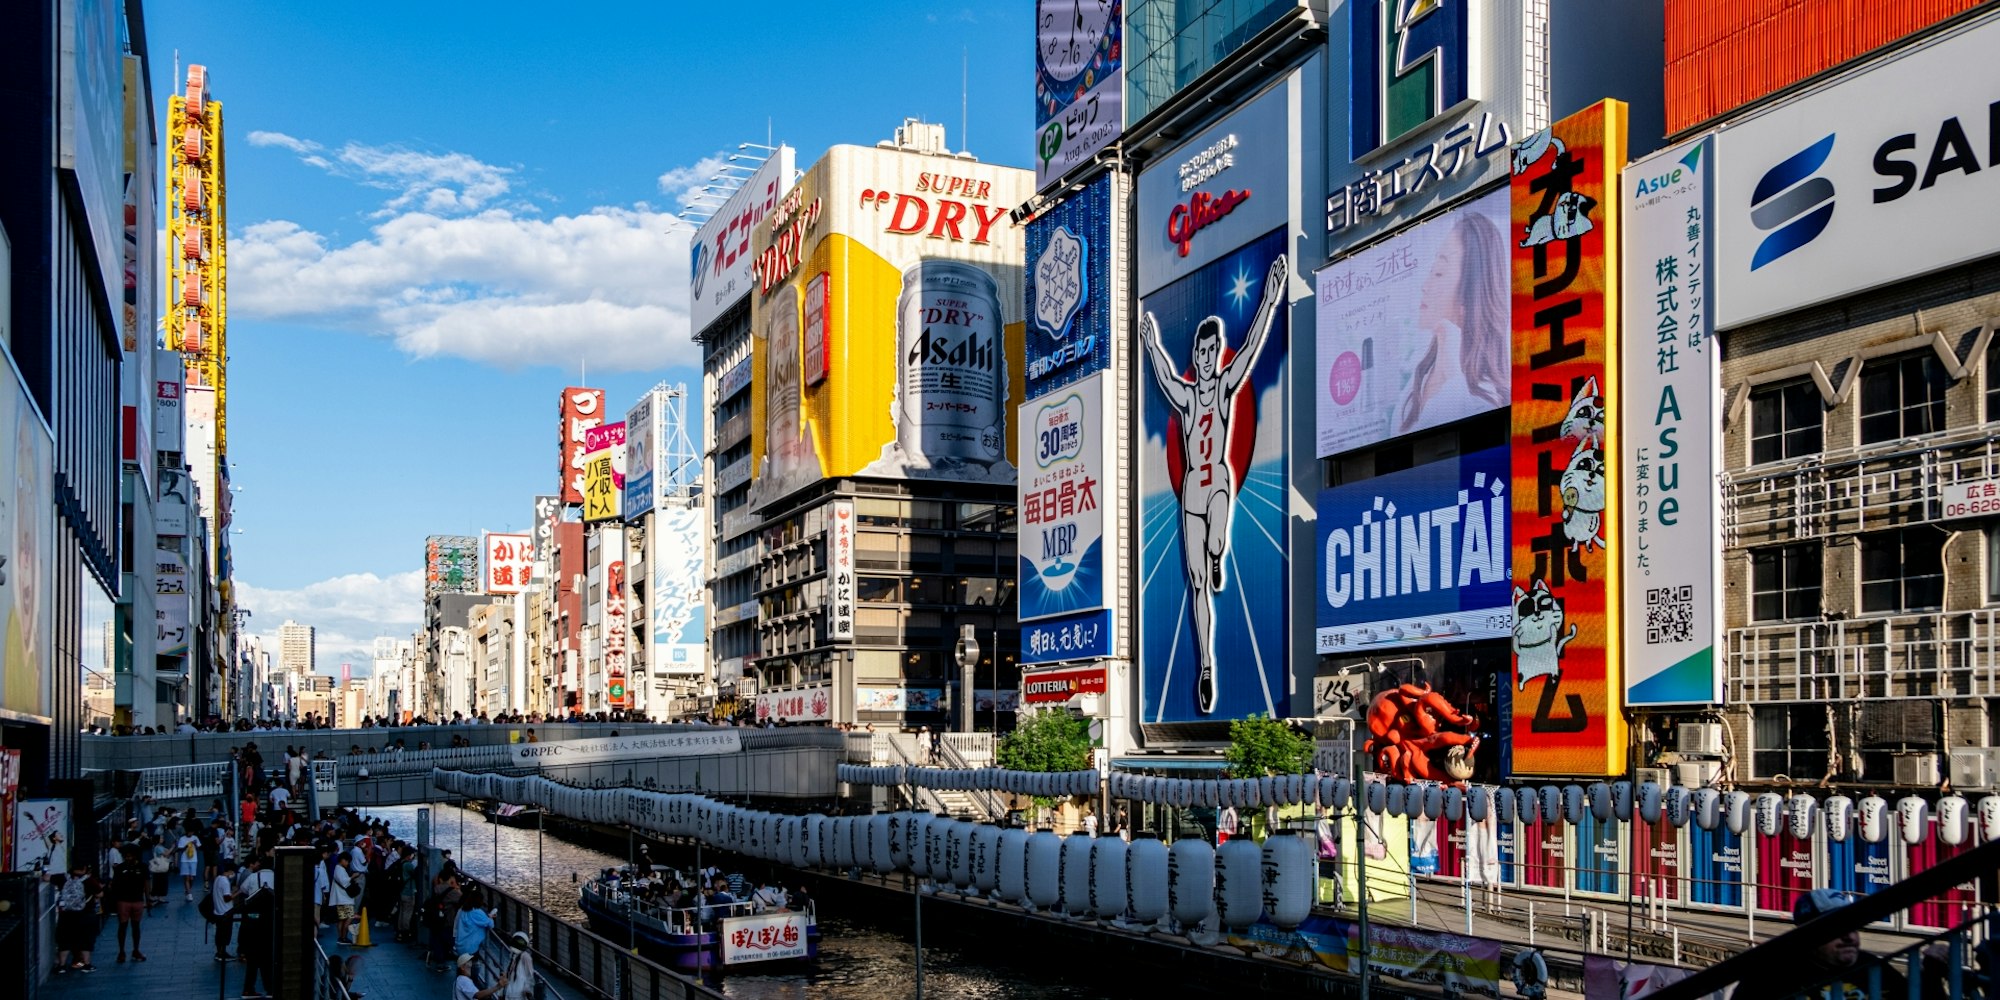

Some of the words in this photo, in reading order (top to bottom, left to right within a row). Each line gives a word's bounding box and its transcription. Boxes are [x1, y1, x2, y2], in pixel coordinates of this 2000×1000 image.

[1049, 37, 1058, 55] 8
[1059, 50, 1068, 67] 7
[1073, 44, 1080, 64] 6
[1065, 92, 1100, 140] ピップ
[1063, 148, 1082, 166] Aug.
[1327, 112, 1513, 236] 日商エステム
[1873, 101, 2000, 205] SA
[916, 171, 992, 198] SUPER
[1635, 168, 1682, 199] Asue
[1167, 188, 1252, 258] Glico
[1687, 205, 1702, 355] 丸善インテックは、
[935, 298, 969, 309] SUPER
[1655, 255, 1680, 375] 株式会社
[907, 327, 994, 374] Asahi
[1029, 335, 1095, 380] 雪印メグミルク
[940, 372, 963, 390] 生
[926, 402, 978, 414] スーパードライ
[1048, 412, 1069, 427] 毎日骨太
[1198, 411, 1215, 487] グリコ
[1529, 151, 1588, 733] オリエントホム
[1655, 384, 1682, 526] Asue
[587, 460, 599, 517] バイト
[599, 456, 612, 515] 高収入
[1033, 462, 1085, 488] まいにちほねぶと
[1024, 476, 1097, 525] 毎日骨太
[1636, 447, 1651, 578] に変わりました。
[838, 523, 850, 567] 本場の味
[1041, 523, 1077, 562] MBP
[1325, 472, 1506, 609] CHINTAI
[606, 594, 625, 677] 大阪王将
[1321, 633, 1346, 647] 天気予報
[1026, 680, 1068, 694] LOTTERIA
[568, 740, 628, 754] 一般社団法人
[1262, 849, 1281, 915] 三津寺
[731, 925, 799, 950] ぽんぽん船
